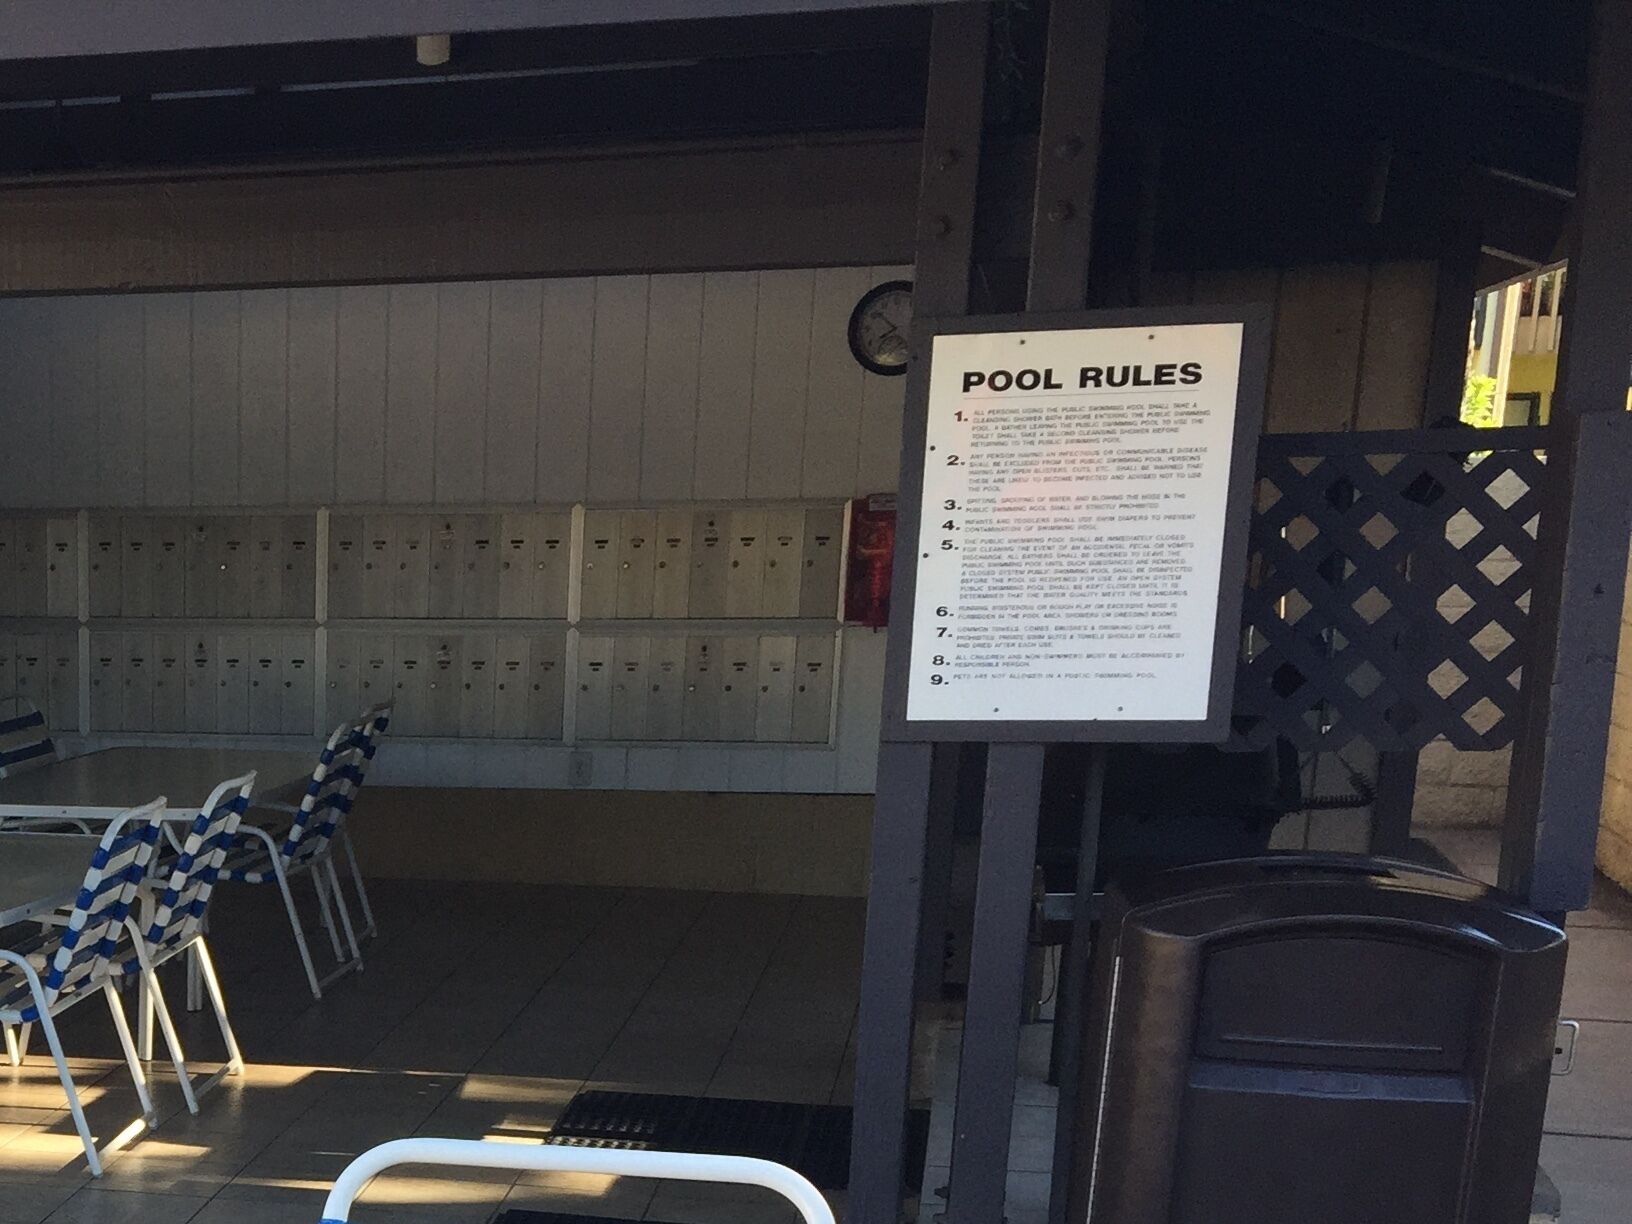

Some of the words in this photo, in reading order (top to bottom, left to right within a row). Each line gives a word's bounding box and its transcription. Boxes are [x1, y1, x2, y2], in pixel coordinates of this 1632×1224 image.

[962, 368, 1063, 393] POOL
[1079, 362, 1203, 388] RULES
[954, 410, 968, 422] 1.
[947, 455, 966, 466] 2.
[944, 499, 962, 511] 3.
[942, 520, 961, 531] 4.
[941, 540, 959, 551] 5.
[936, 606, 954, 617] 6.
[936, 627, 953, 638] 7.
[932, 655, 951, 666] 8.
[930, 674, 949, 685] 9.
